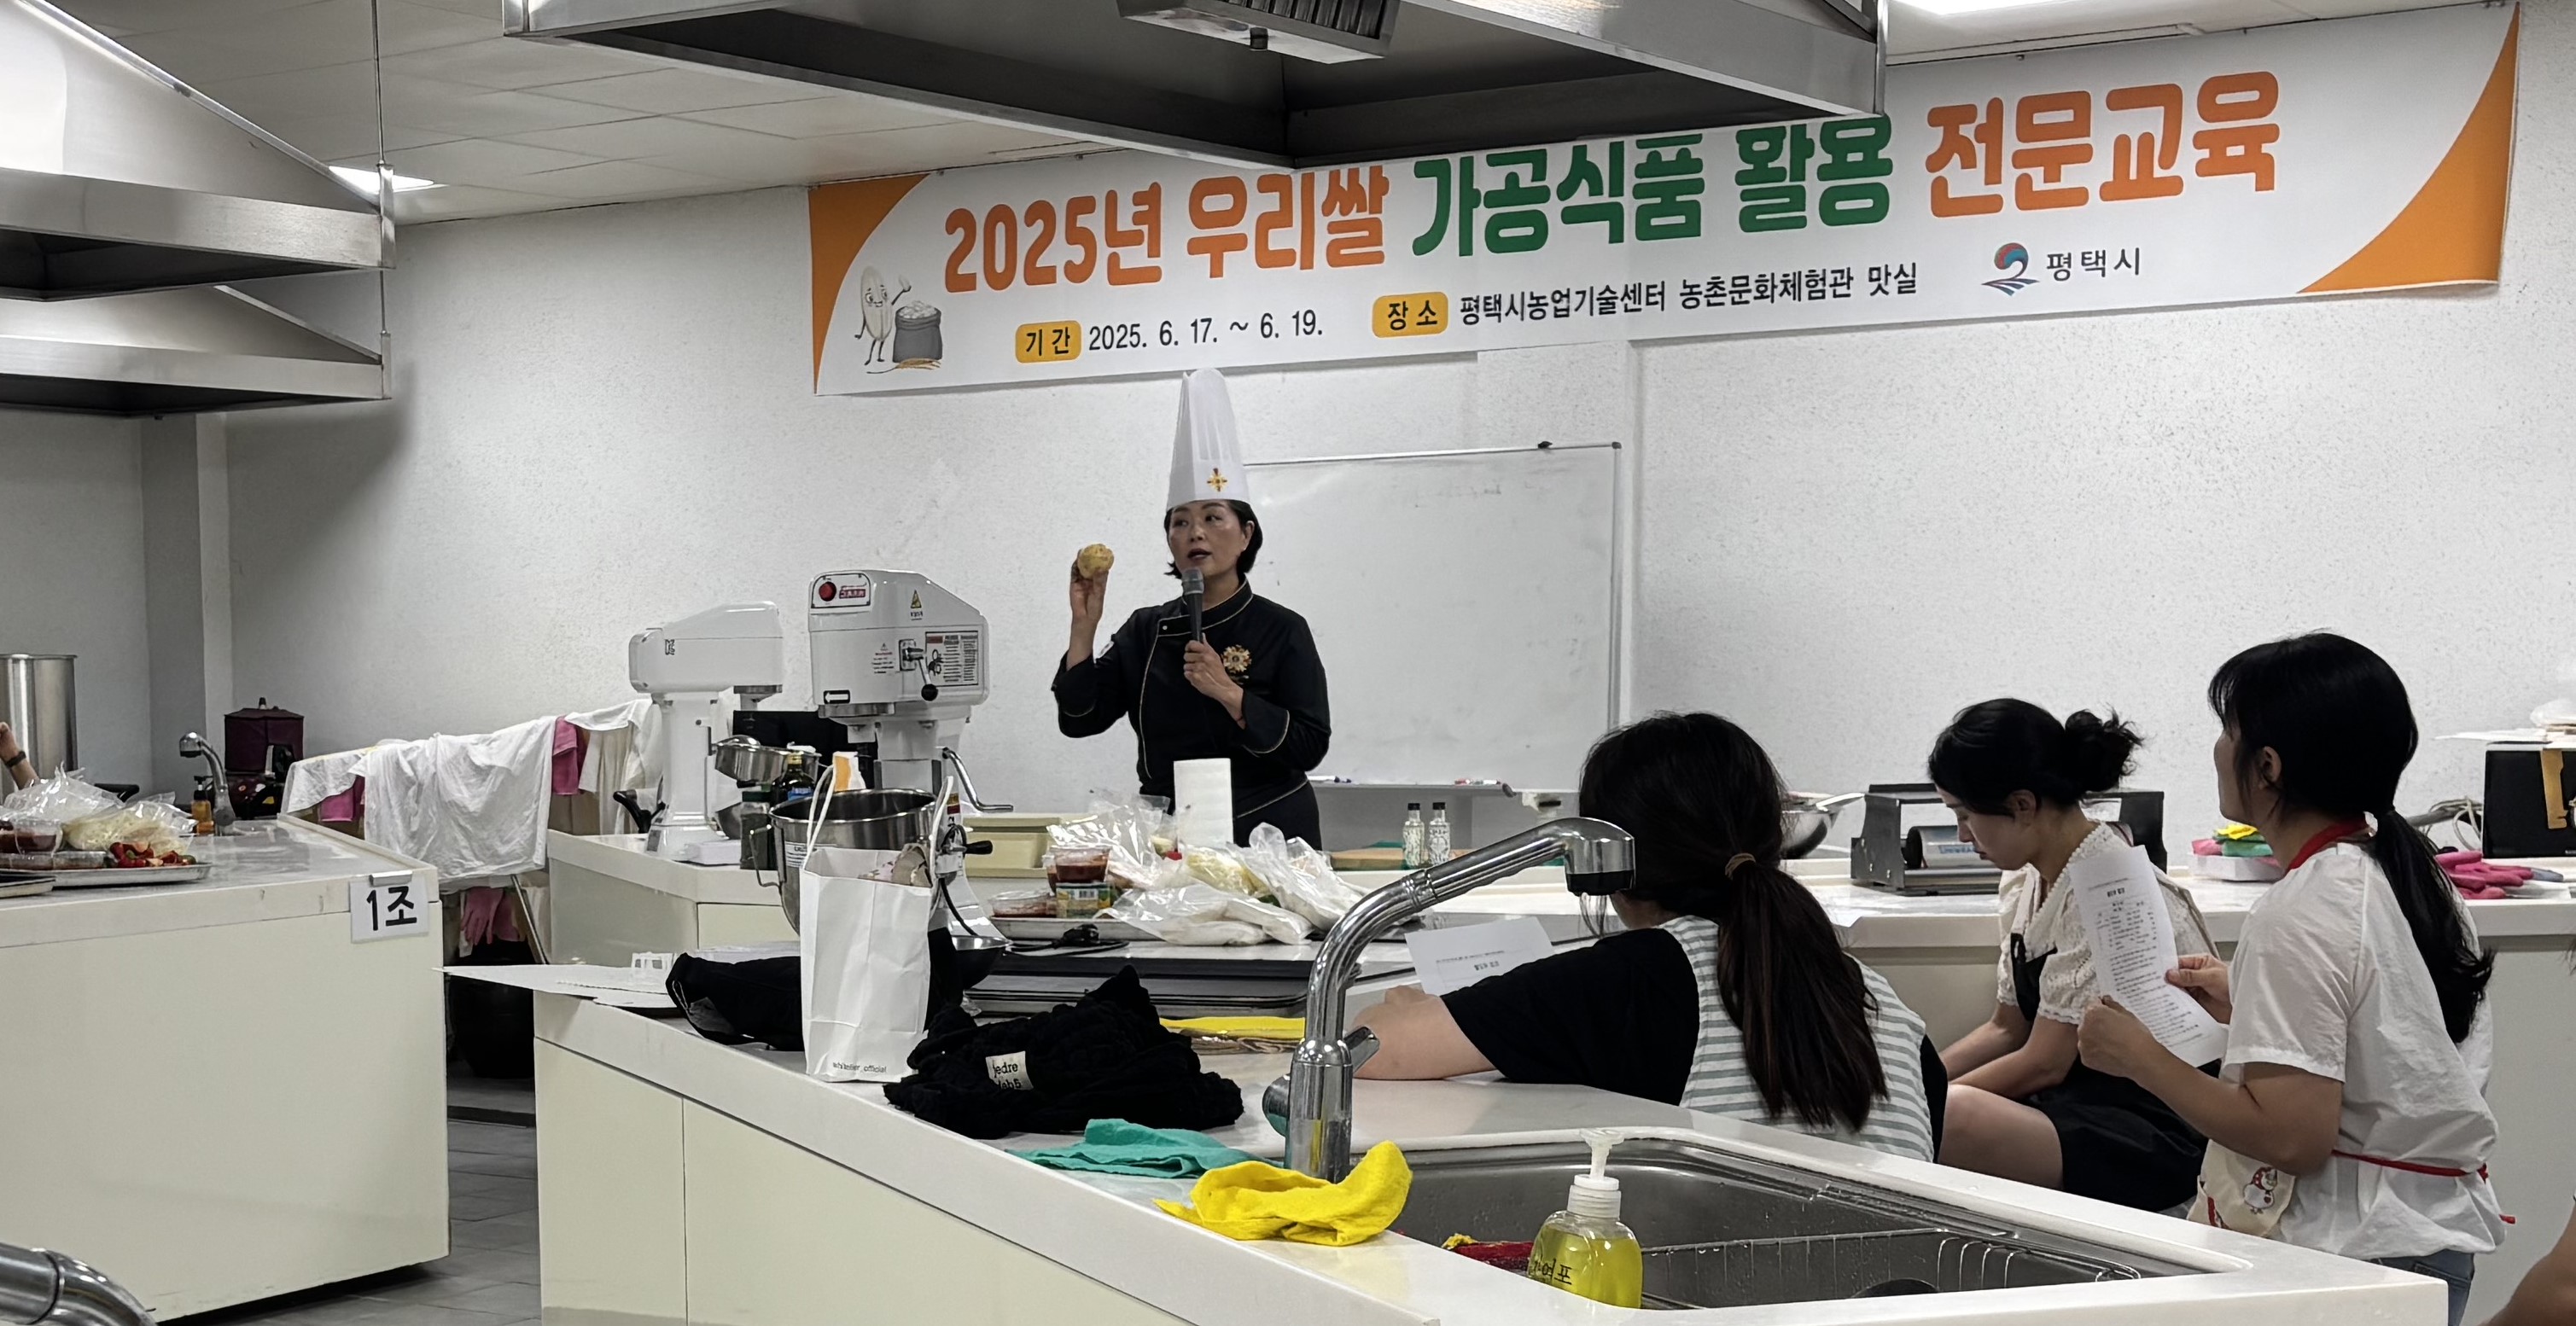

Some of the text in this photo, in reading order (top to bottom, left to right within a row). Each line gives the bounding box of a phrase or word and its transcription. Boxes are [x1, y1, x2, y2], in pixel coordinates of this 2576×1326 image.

[945, 70, 2281, 293] 2025년 우리쌀 가공식품 활용 전문교육
[2046, 247, 2141, 282] 평택시
[1460, 262, 1917, 326] 평택시농업기술센터 농촌문화체험관 맛실
[1088, 323, 1147, 351] 2025.
[1159, 320, 1179, 346] 6.
[1190, 317, 1218, 345] 17.
[1260, 312, 1279, 339] 6.
[1291, 309, 1323, 337] 19.
[366, 885, 417, 932] 1조
